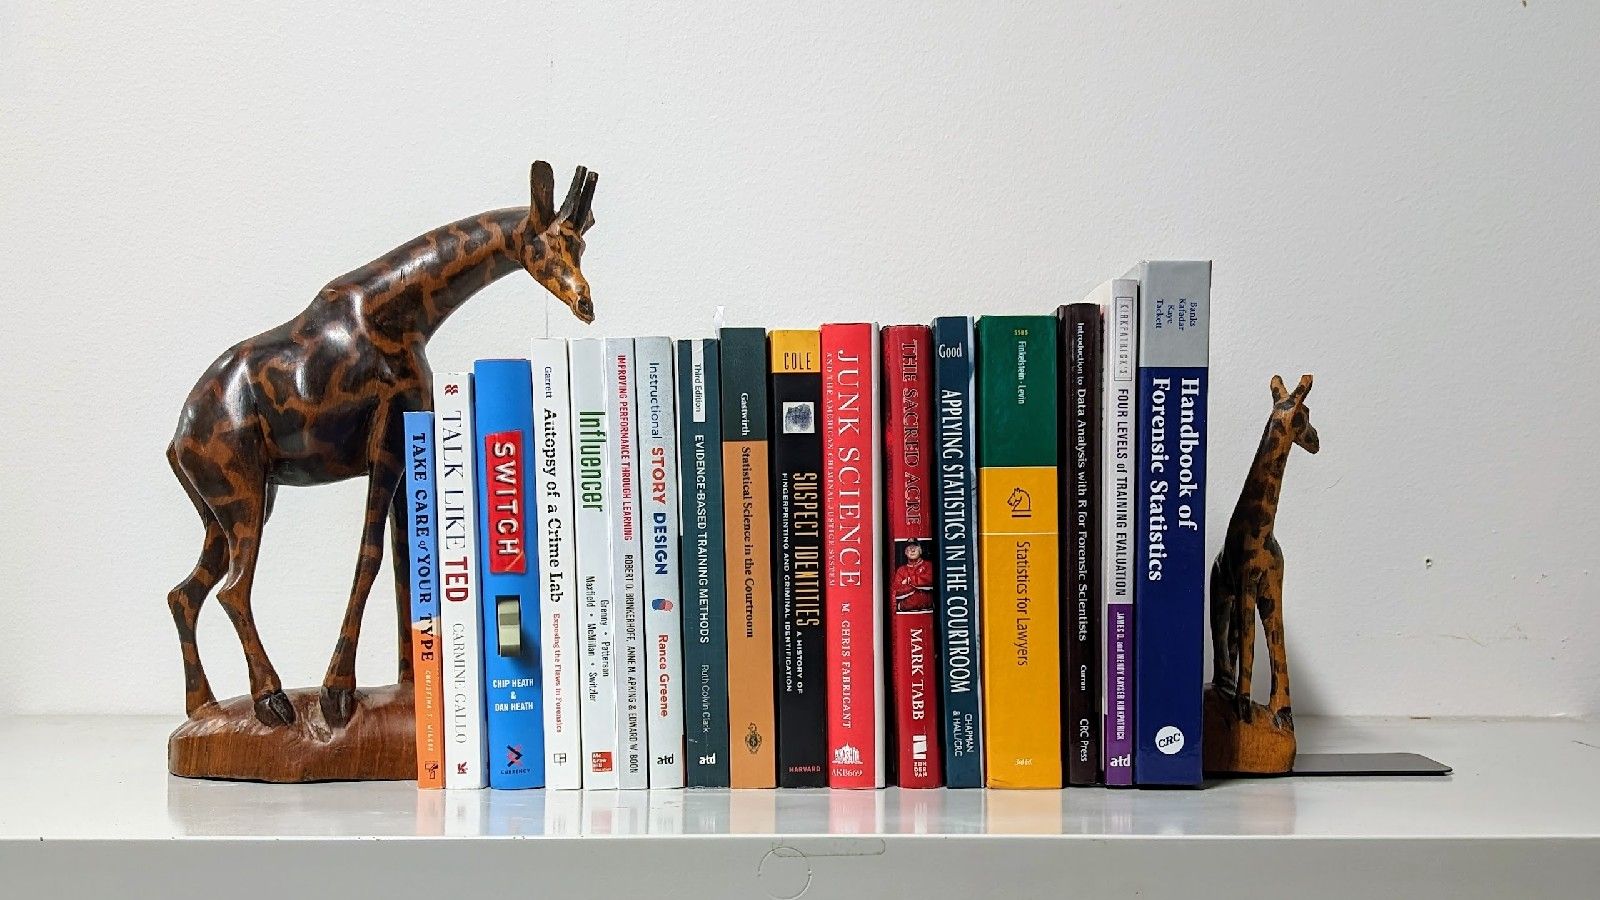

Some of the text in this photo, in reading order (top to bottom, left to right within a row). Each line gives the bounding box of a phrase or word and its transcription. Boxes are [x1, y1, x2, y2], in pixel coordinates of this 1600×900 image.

[1155, 298, 1164, 328] Tackett
[1166, 304, 1176, 324] Kaye
[1178, 298, 1187, 331] Kafadar
[1190, 302, 1198, 326] Banks
[784, 352, 812, 370] COLE
[938, 342, 962, 358] Good
[1119, 304, 1129, 375] KIRKPATRICK'S
[694, 363, 704, 412] Third Edition
[1018, 341, 1026, 404] Finkelstein Levin
[740, 392, 750, 436] Gastwirth
[902, 339, 922, 526] THE SACRED ACRE
[580, 411, 606, 512] Influencer
[617, 355, 633, 540] IMPROVING PERFORMANCE THROUGH LEARNING
[649, 362, 668, 576] Instructional STORY DESIGN
[838, 349, 861, 588] JUNK SCIENCE
[1178, 378, 1200, 530] Handbook of
[494, 442, 520, 556] SWITCH
[542, 366, 564, 602] Garrett Autopsy of a Crime Lab
[1075, 322, 1088, 641] Introduction to Data Analysis with R for Forensic Scientists
[1115, 388, 1128, 596] FOUR LEVELS of TRAINING EVALUATION
[1148, 378, 1170, 581] Forensic Statistics
[442, 410, 468, 602] TALK LIKE TED
[782, 473, 790, 549] FINGERPRINTING
[412, 433, 434, 662] TAKE CARE of YOUR TYPE
[694, 434, 710, 644] EVIDENCE-BASED TRAINING METHODS
[741, 446, 756, 638] Statistical Science in the Courtroom
[793, 472, 820, 626] SUSPECT IDENTITIES
[941, 390, 970, 692] APPLYING STATISTICS IN THE COURTROOM
[624, 554, 634, 582] ROBERT
[626, 593, 636, 642] BRINKERHOFF,
[784, 574, 792, 618] CRIMINAL
[1013, 540, 1032, 666] Statistics for Lawyers
[552, 613, 561, 648] Exposing
[586, 576, 598, 702] Maxfield McMillan Switzler
[600, 599, 610, 677] Grenny Patterson
[1116, 611, 1125, 632] JAMES
[627, 646, 636, 664] ANNE
[784, 621, 793, 692] IDENTIFICATION
[842, 603, 852, 728] M. CHRIS FABRICANT
[1116, 641, 1125, 652] and
[1116, 653, 1125, 676] WENDY
[453, 623, 467, 744] CARMINE GALLO
[492, 678, 534, 688] CHIP HEATH
[628, 666, 636, 674] M.
[628, 676, 638, 702] APKING
[658, 634, 671, 718] Rance Greene
[796, 681, 804, 694] OF
[910, 628, 925, 720] MARK TABB
[1116, 676, 1125, 700] KAYSER
[494, 702, 534, 712] DAN HEATH
[510, 690, 517, 700] &
[555, 698, 563, 733] Forensics
[701, 664, 711, 733] Ruth Colvin Clark
[628, 713, 638, 742] EDWARD
[954, 718, 963, 756] HALL/CRC
[964, 713, 974, 752] CHAPMAN
[1080, 718, 1090, 761] CRC Press
[1116, 700, 1125, 740] KIRKPATRICK
[1158, 732, 1180, 749] CRC
[630, 743, 638, 752] W.
[630, 754, 640, 774] BOON
[657, 754, 674, 765] atd
[699, 753, 716, 765] atd
[1110, 754, 1130, 767] atd
